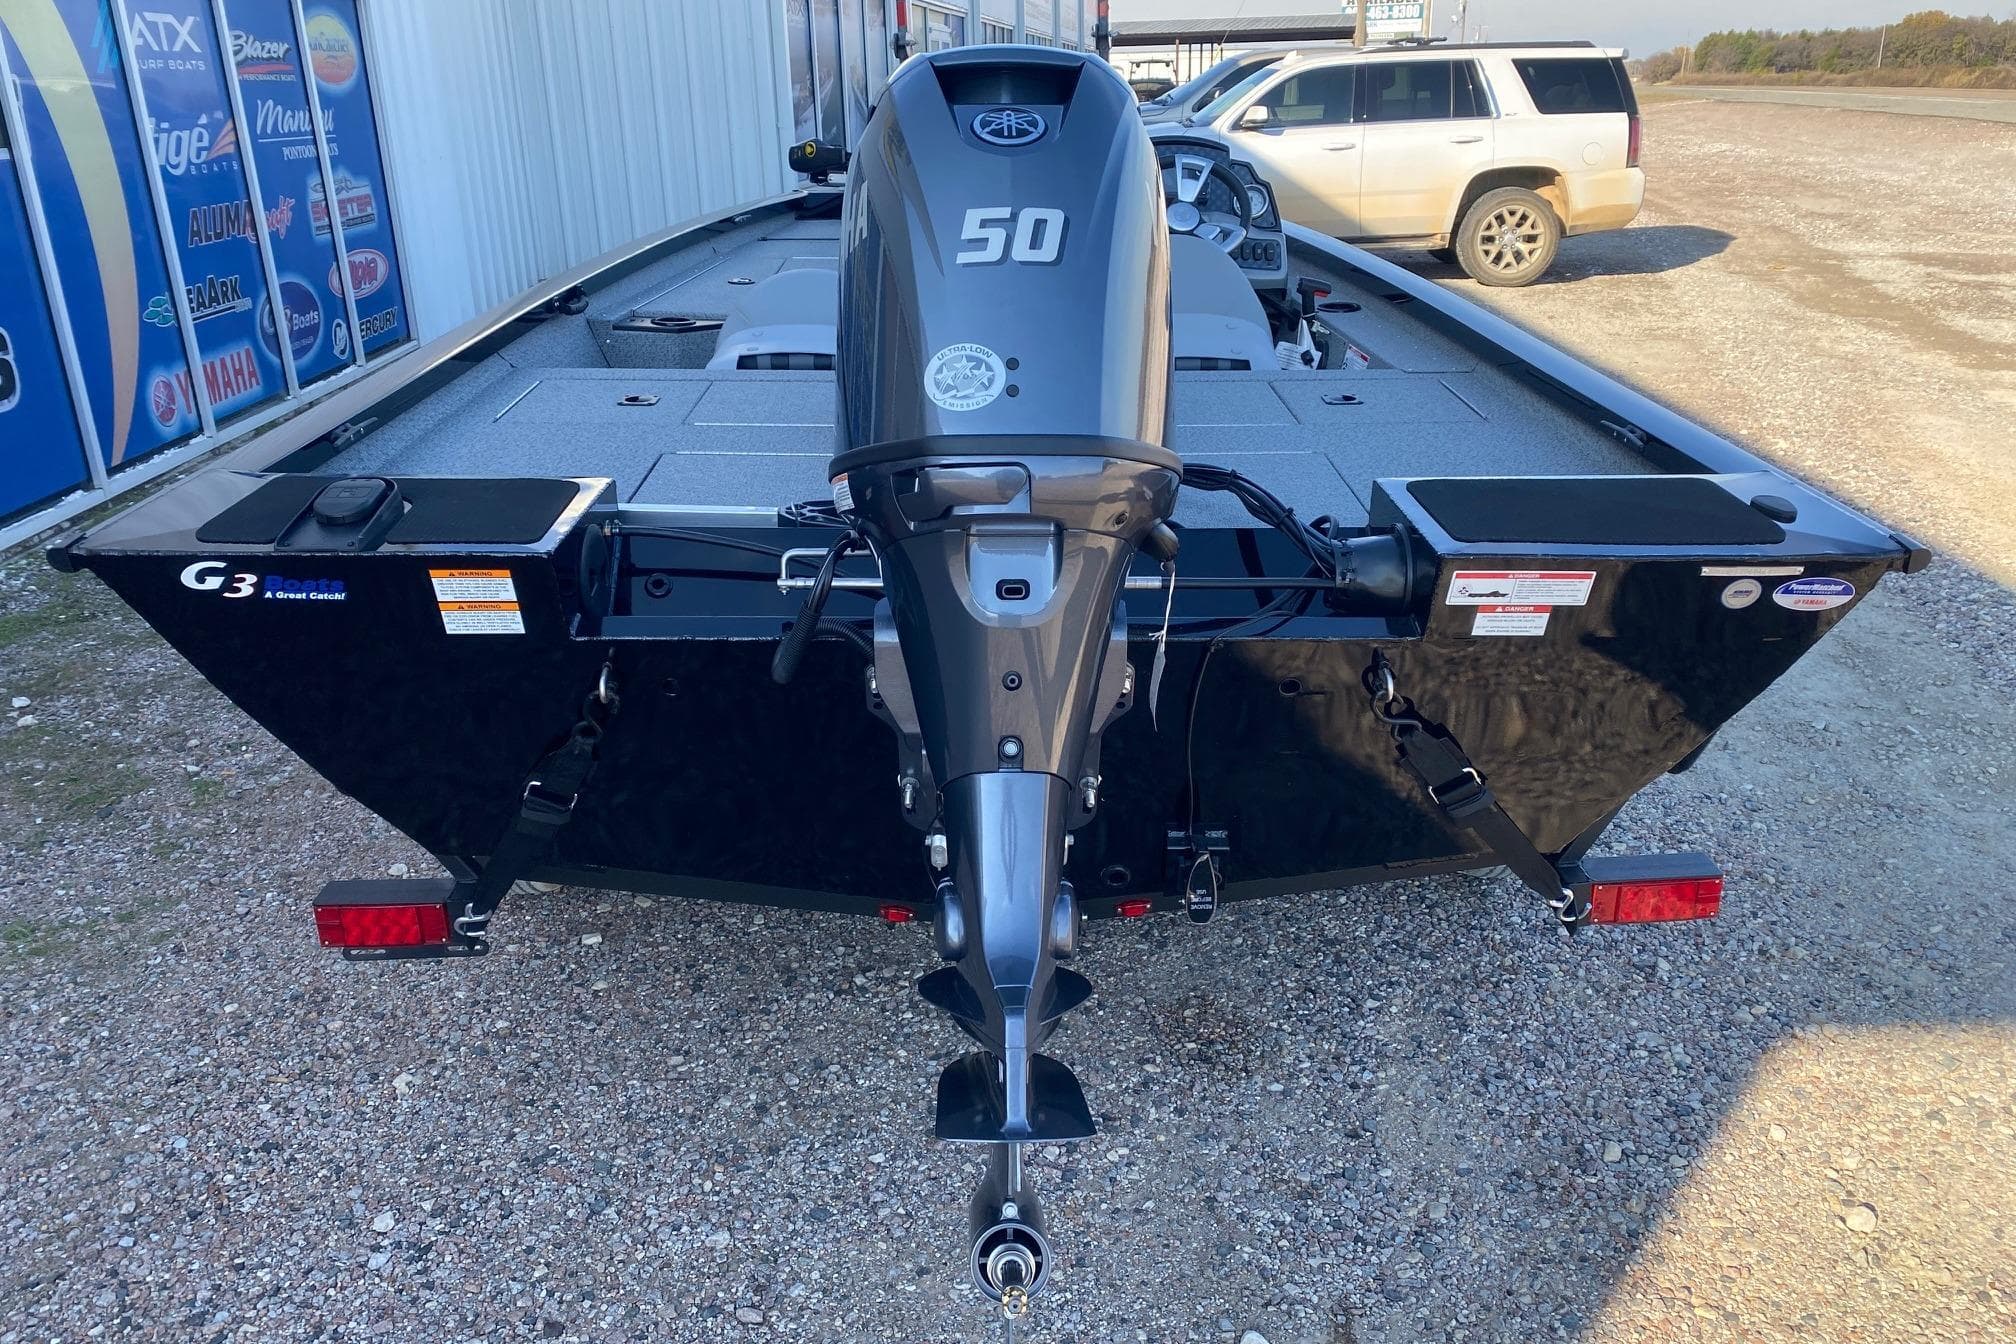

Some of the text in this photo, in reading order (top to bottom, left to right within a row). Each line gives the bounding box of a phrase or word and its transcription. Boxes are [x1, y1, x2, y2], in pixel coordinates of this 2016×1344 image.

[131, 12, 202, 52] ATX
[230, 29, 289, 62] Blazer
[141, 60, 205, 70] URF BOATS
[190, 160, 239, 174] BOATS
[956, 207, 1065, 264] 50
[292, 311, 319, 331] Boats
[359, 306, 398, 340] ERCURY
[174, 347, 260, 415] YMAHA
[180, 561, 345, 598] G3 Boats
[275, 591, 307, 599] Great
[309, 592, 346, 600] Catch!
